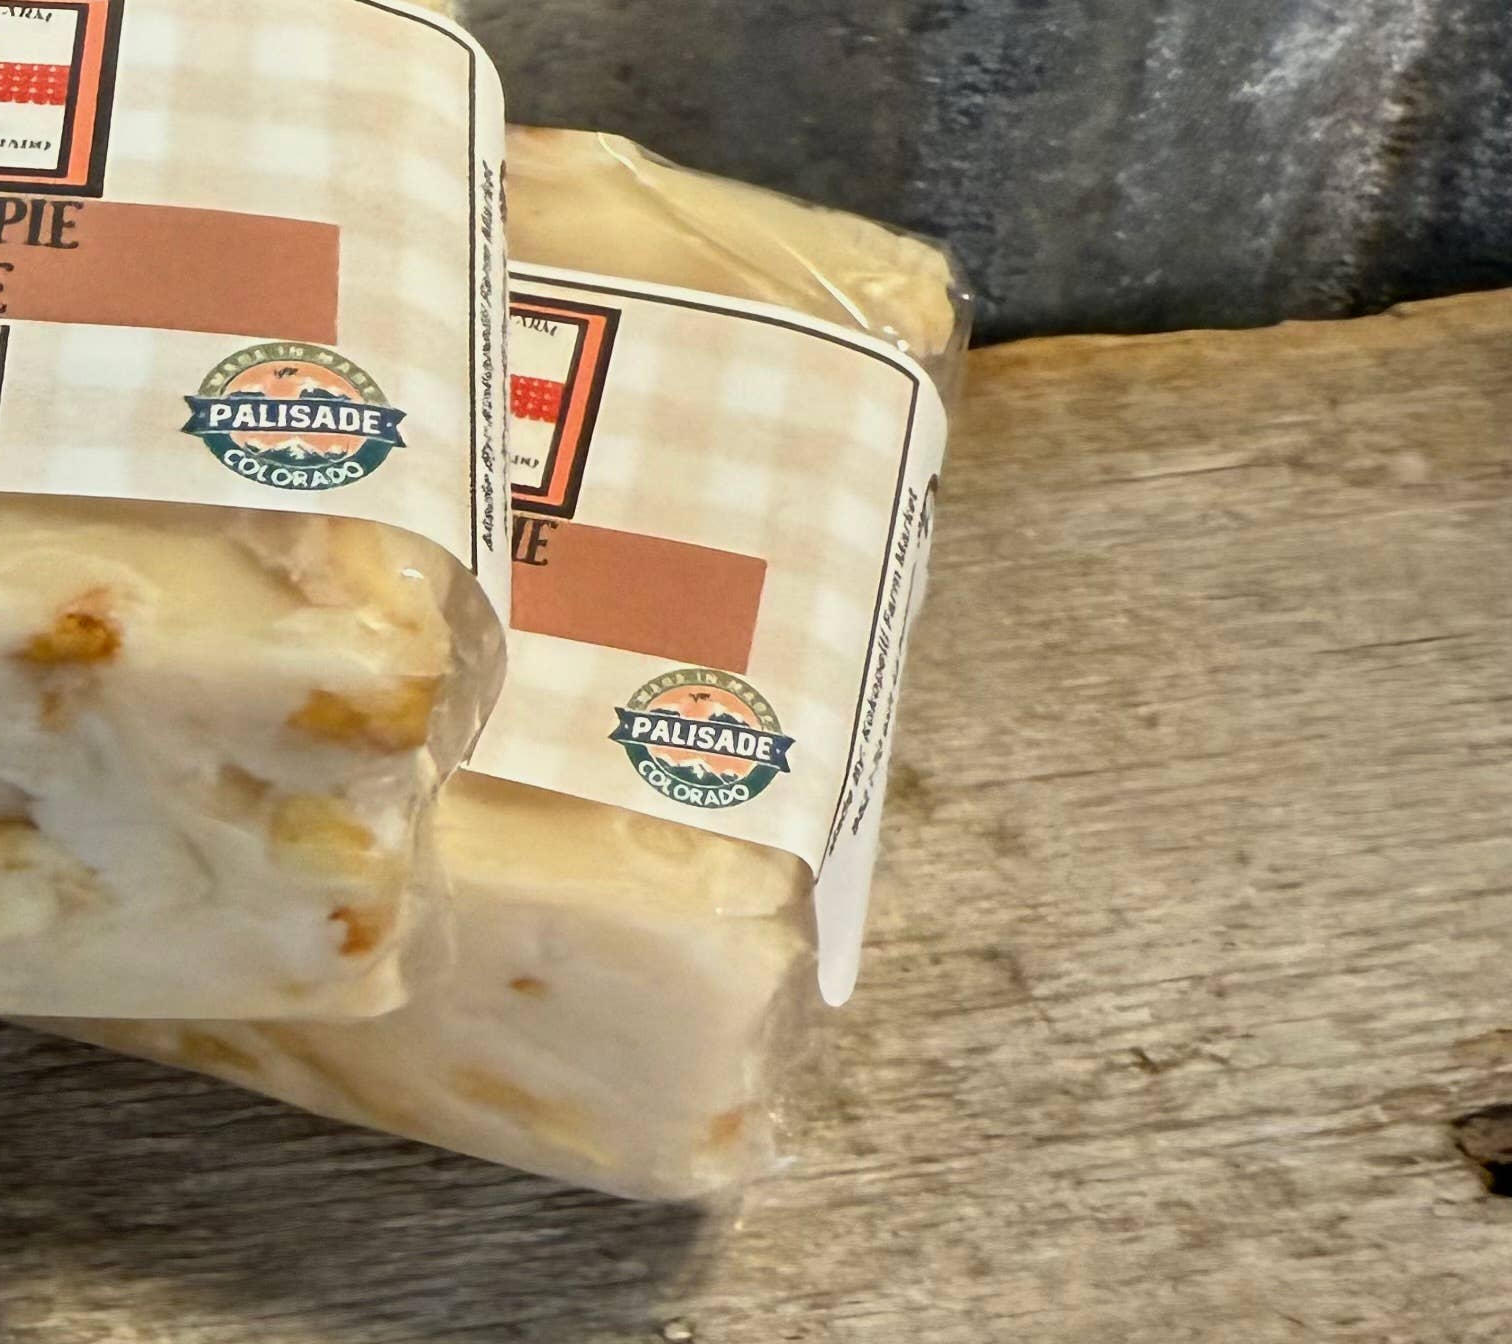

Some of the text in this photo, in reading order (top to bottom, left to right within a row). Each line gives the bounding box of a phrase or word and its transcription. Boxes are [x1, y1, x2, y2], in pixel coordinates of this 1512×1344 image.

[208, 403, 382, 435] PALISADE
[223, 448, 365, 489] COLORADO
[511, 514, 559, 567] IE
[631, 716, 774, 761] PALISADE
[638, 760, 750, 806] COLORADO
